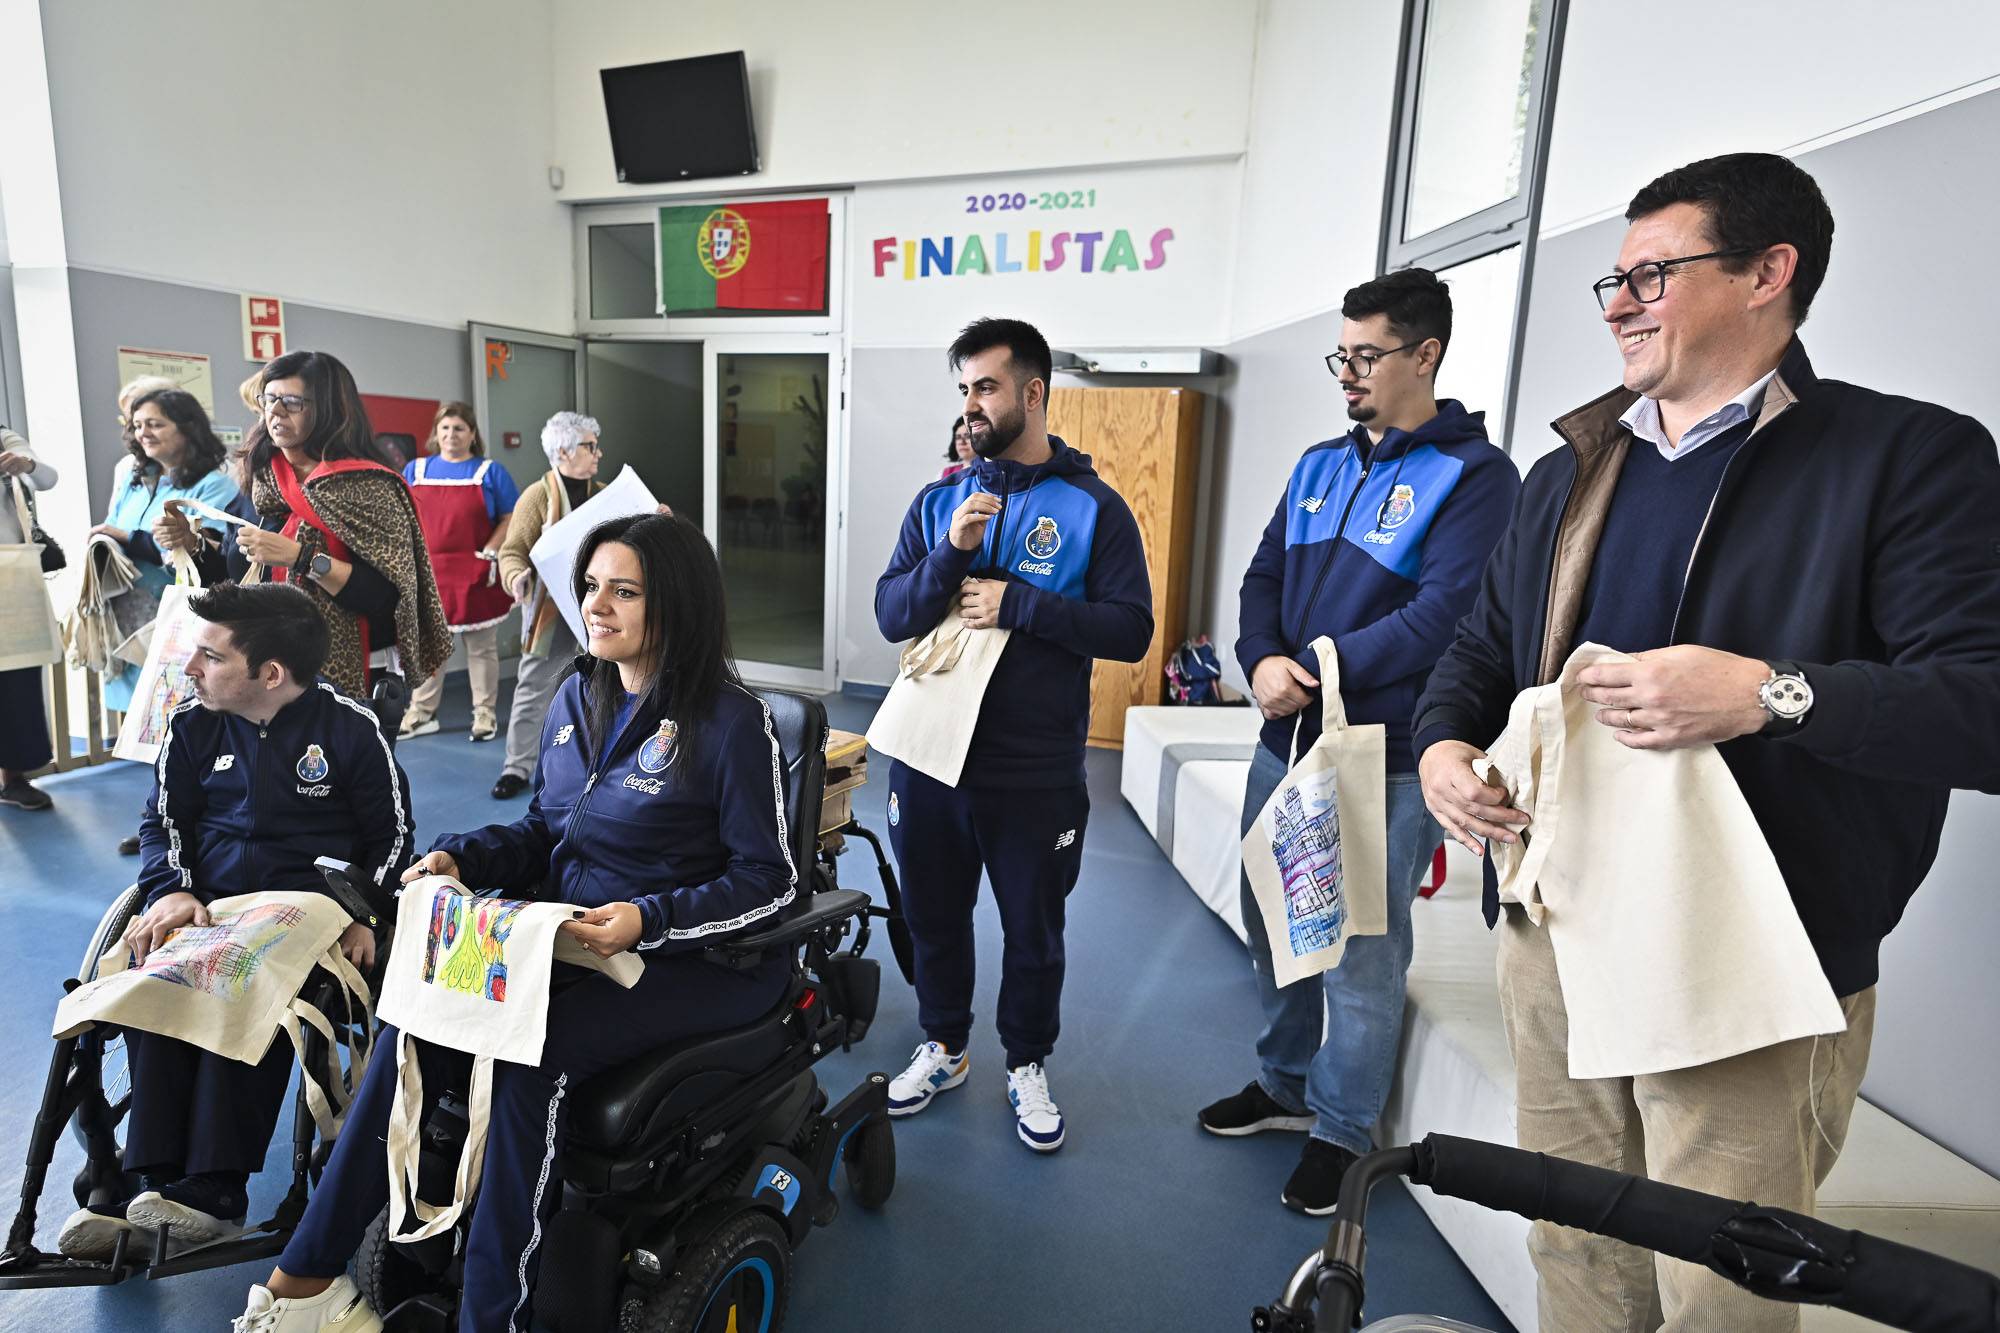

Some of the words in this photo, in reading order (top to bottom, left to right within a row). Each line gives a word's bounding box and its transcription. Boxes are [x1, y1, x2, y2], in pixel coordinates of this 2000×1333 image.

[966, 189, 1096, 213] 2020-2021
[873, 228, 1175, 280] FINALISTAS
[728, 919, 743, 928] new
[744, 906, 772, 921] balance
[771, 1170, 791, 1190] F3
